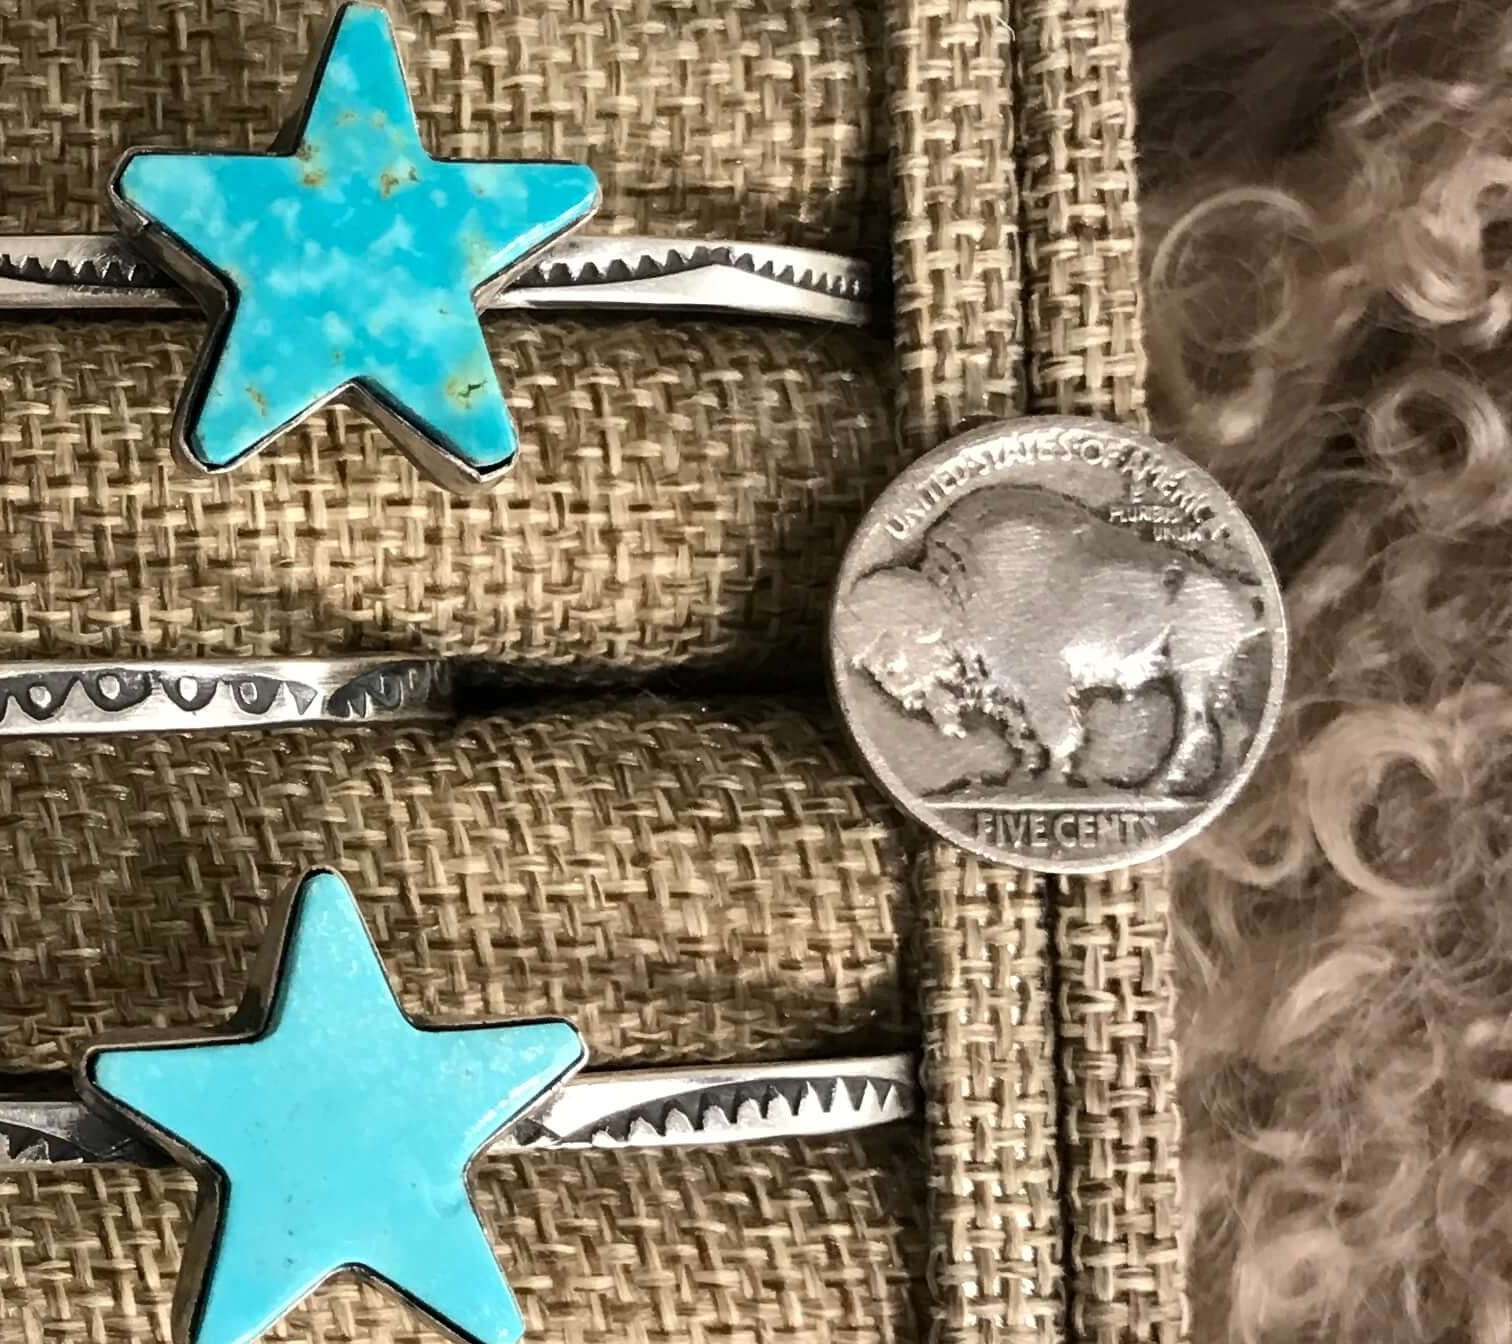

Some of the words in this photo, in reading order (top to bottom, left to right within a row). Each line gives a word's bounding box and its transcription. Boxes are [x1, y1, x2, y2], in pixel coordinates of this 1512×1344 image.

[884, 456, 970, 541] UNITED
[962, 426, 1073, 476] STATES
[1080, 436, 1122, 469] OF
[1121, 448, 1233, 542] AMERICA
[976, 811, 1049, 849] FIVE
[1052, 811, 1160, 849] CENTS
